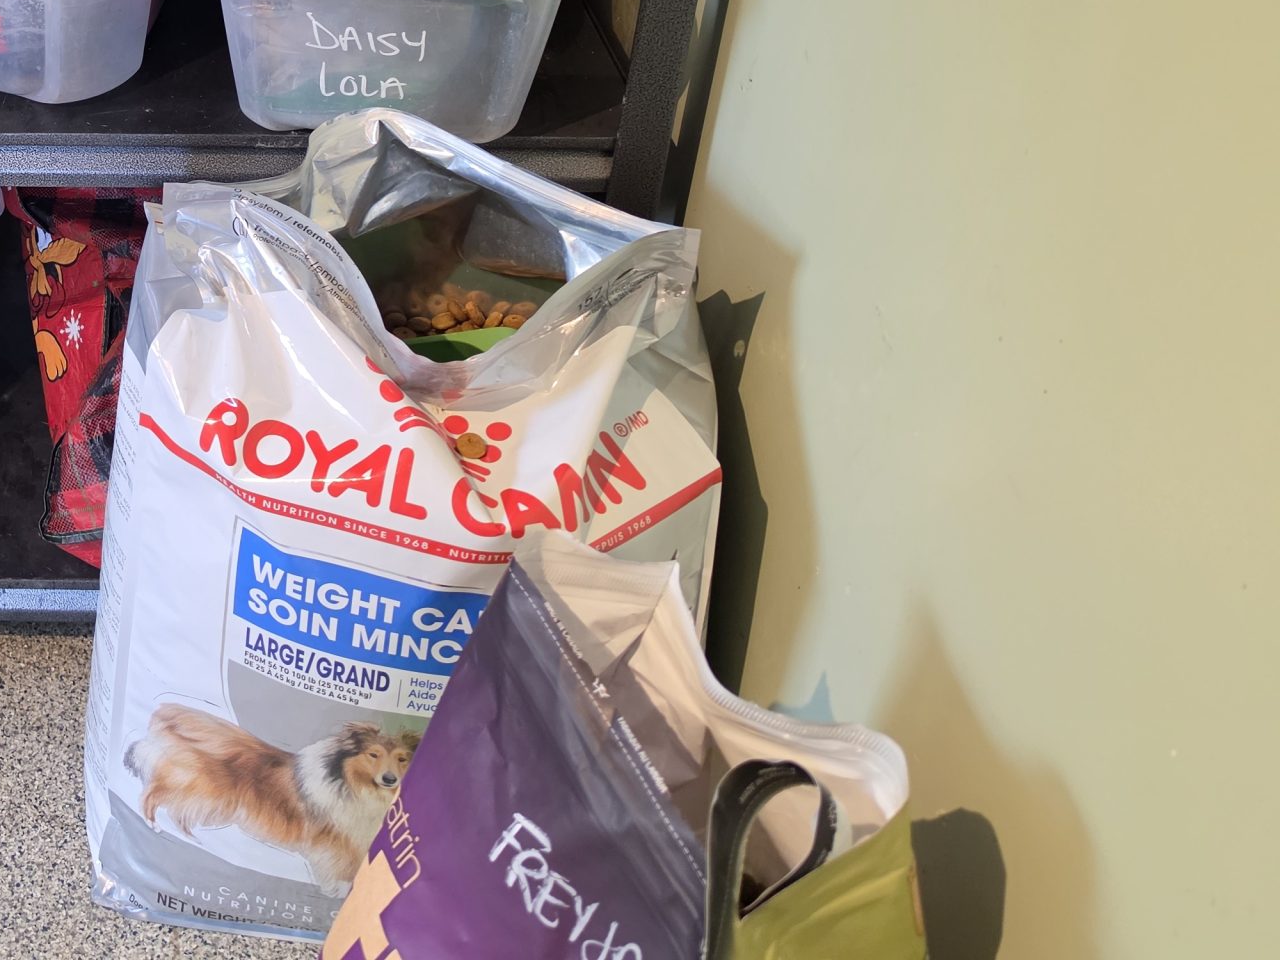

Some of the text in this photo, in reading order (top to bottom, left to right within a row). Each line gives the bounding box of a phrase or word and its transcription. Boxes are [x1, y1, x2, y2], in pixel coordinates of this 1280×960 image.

[305, 11, 427, 61] DAISY
[292, 220, 344, 262] refermable
[199, 397, 428, 521] ROYAL
[214, 471, 257, 504] HEALTH
[261, 499, 338, 527] NUTRITION
[343, 519, 388, 540] SINCE
[394, 533, 430, 552] 1968
[626, 514, 653, 536] 1968
[252, 553, 485, 635] WEIGHT CA
[247, 587, 464, 664] SOIN MINC
[243, 658, 254, 668] DE
[255, 663, 266, 674] 25
[274, 673, 284, 683] 45
[285, 677, 296, 688] kg
[303, 684, 315, 693] DE
[316, 688, 327, 697] 25
[336, 694, 349, 703] 45
[349, 696, 360, 706] kg
[244, 650, 266, 666] FROM
[268, 660, 277, 670] 56
[277, 665, 290, 676] TO
[292, 669, 306, 682] 100
[308, 675, 317, 685] lb
[333, 685, 345, 694] TO
[346, 687, 358, 697] 45
[358, 689, 373, 701] kg)
[245, 626, 391, 692] LARGE/GRAND
[407, 688, 438, 702] Aide
[409, 676, 444, 692] Helps
[156, 891, 189, 914] NET
[183, 885, 314, 924] NUTRITION
[218, 886, 312, 915] CANINE
